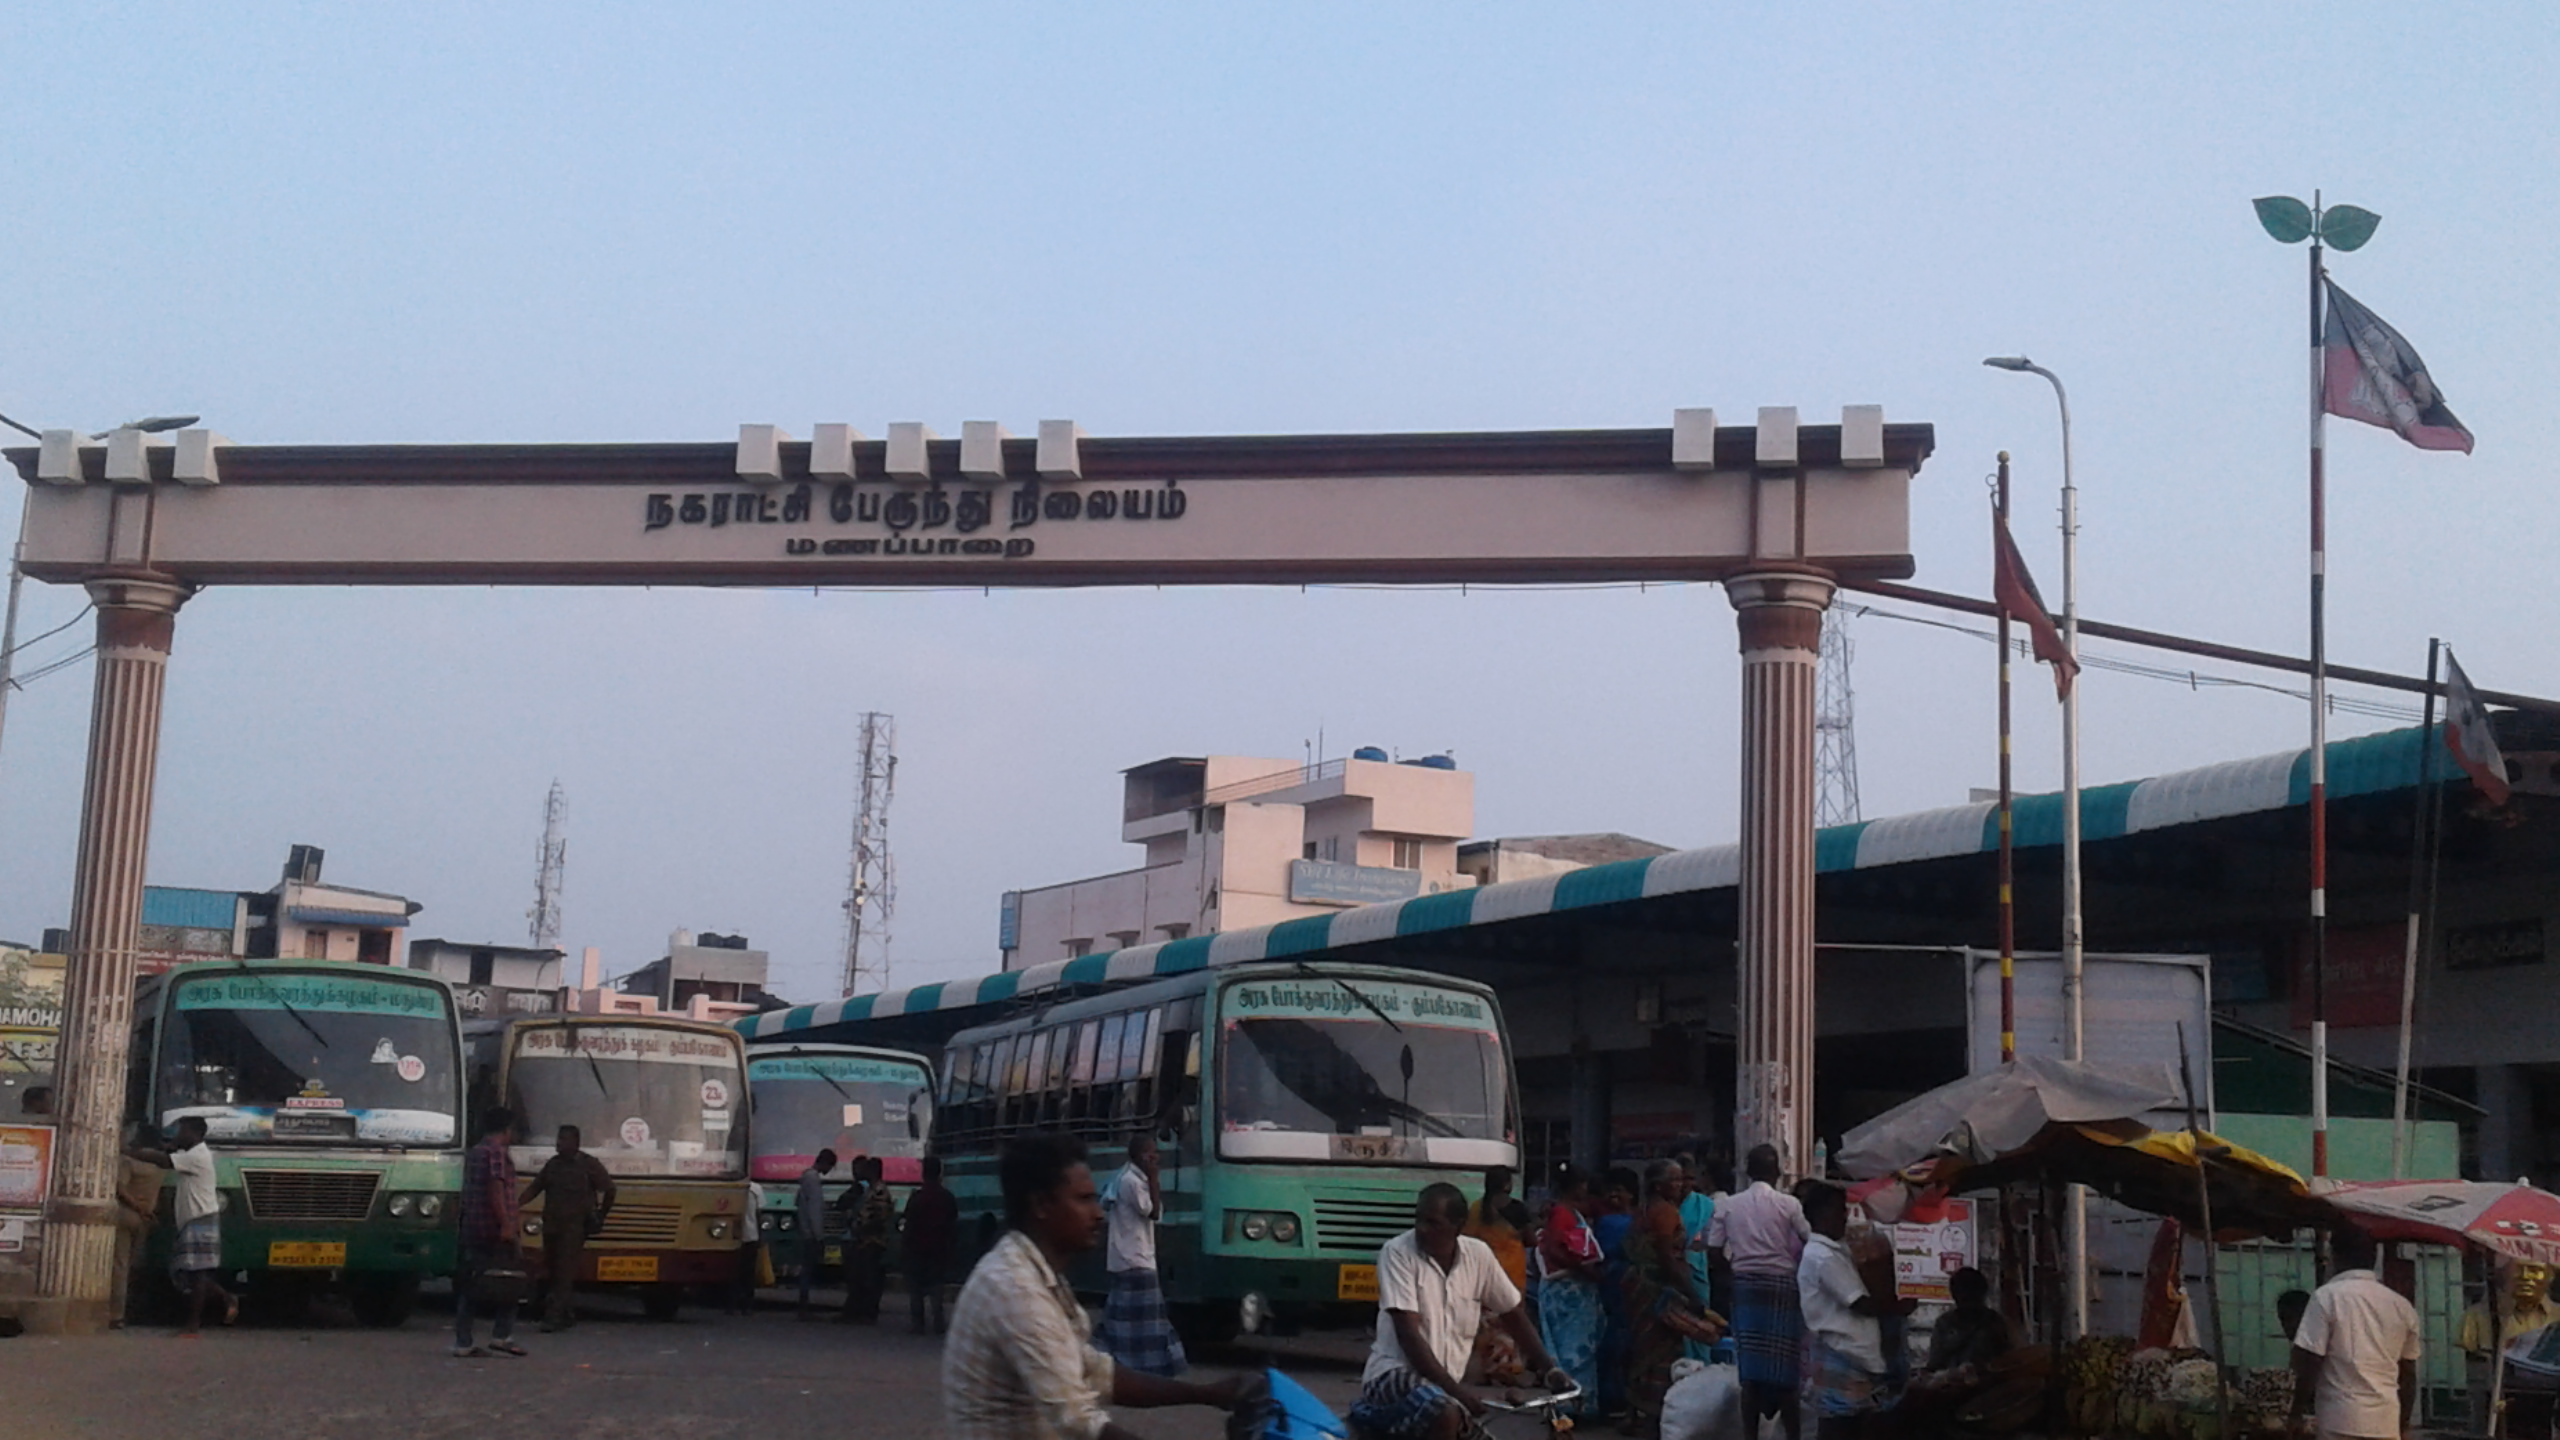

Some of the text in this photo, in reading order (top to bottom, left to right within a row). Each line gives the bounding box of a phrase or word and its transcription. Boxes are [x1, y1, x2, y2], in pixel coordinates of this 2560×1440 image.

[645, 478, 1188, 534] நகராட்சி பேருந்து நிலையம்
[785, 531, 1036, 558] மணப்பாறை
[187, 986, 223, 1003] அரசு
[1239, 987, 1269, 1009] அரசு
[0, 1007, 62, 1027] AMOHA
[527, 1032, 553, 1050] அரசு
